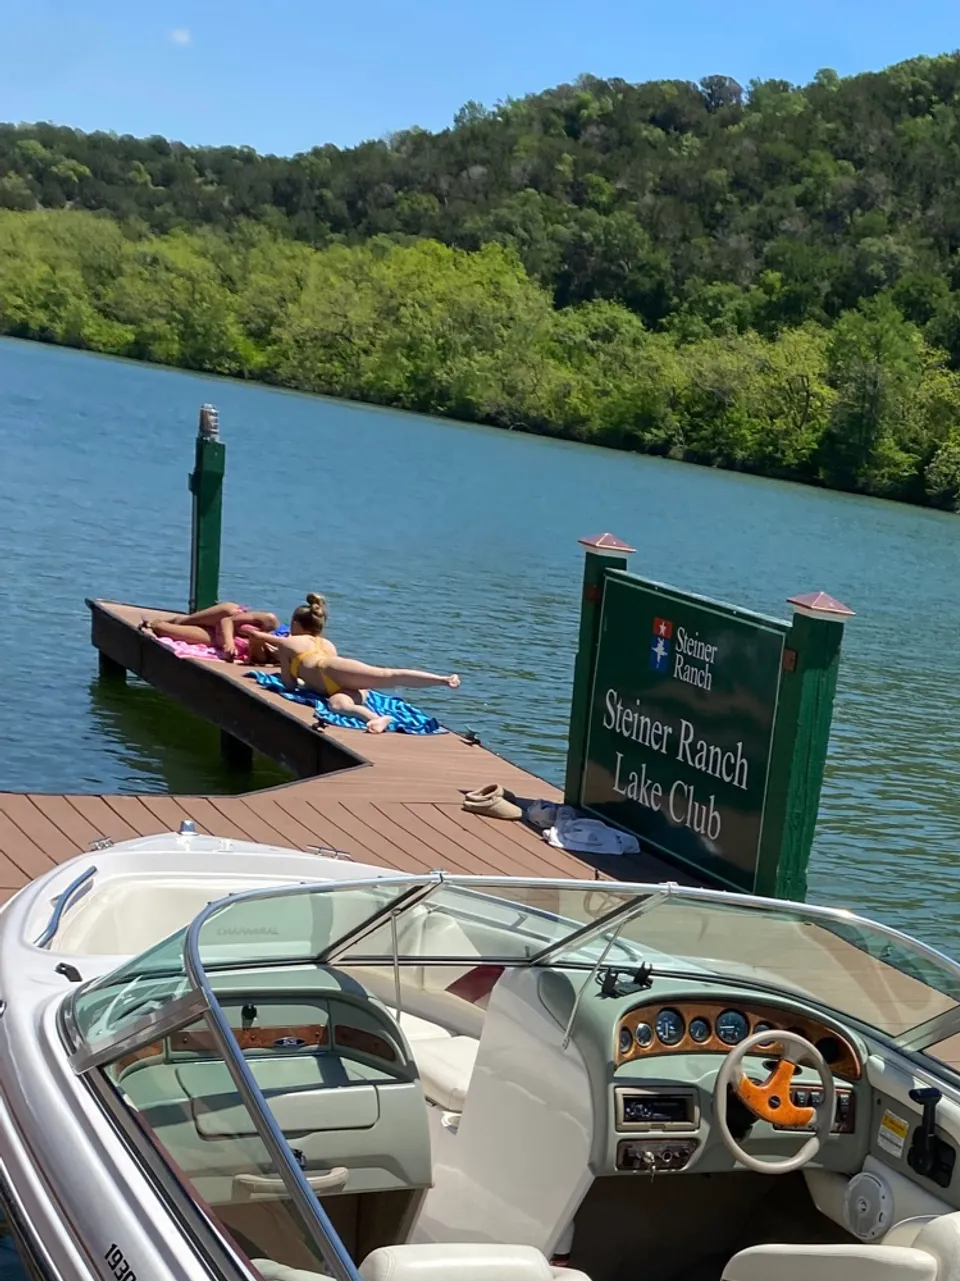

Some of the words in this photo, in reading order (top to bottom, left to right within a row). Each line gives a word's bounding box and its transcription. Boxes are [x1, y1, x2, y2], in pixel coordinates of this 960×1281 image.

[673, 653, 713, 691] Ranch
[675, 626, 718, 664] Steiner
[603, 688, 672, 755] Steiner
[677, 718, 749, 791] Ranch
[612, 751, 663, 813] Lake
[669, 780, 722, 841] Club
